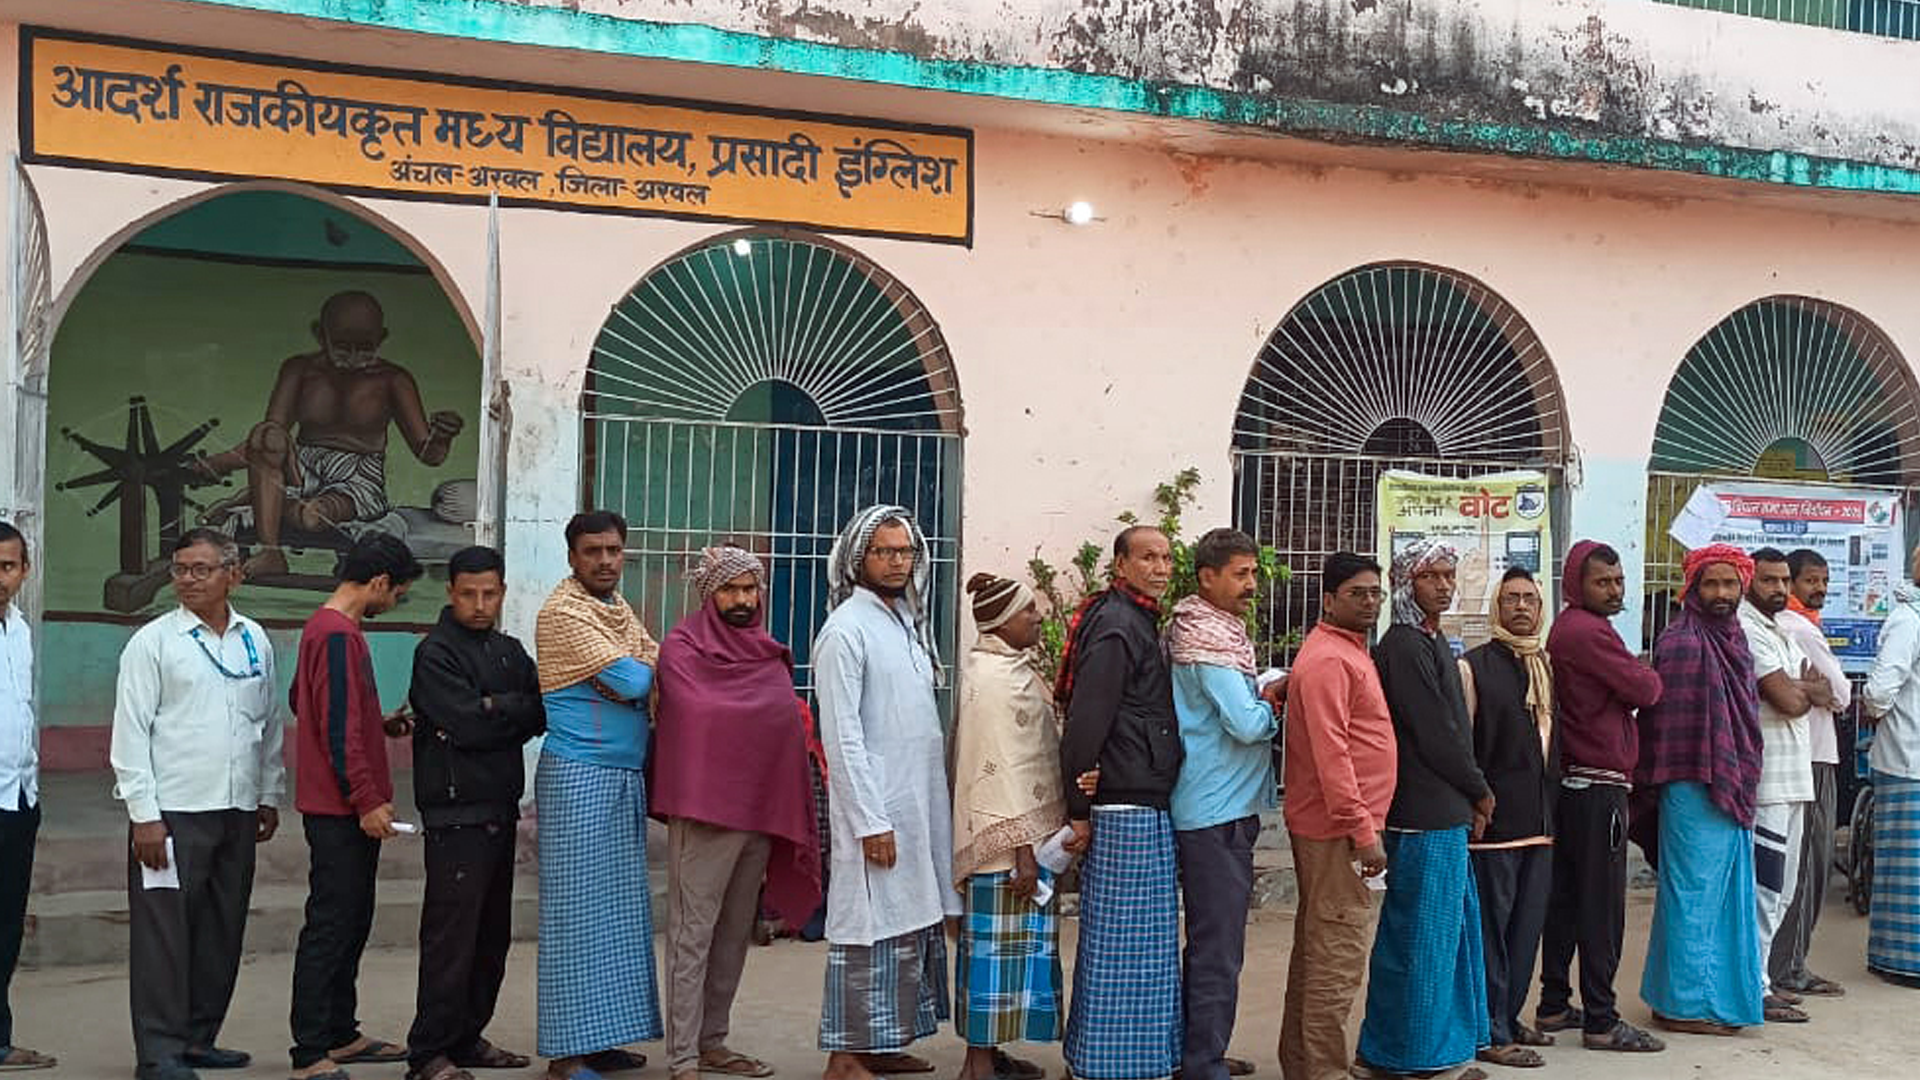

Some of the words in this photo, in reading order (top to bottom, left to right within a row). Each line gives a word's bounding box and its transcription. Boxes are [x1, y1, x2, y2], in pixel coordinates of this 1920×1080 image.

[52, 64, 185, 123] आदर्श
[193, 80, 428, 160] राजकीयकृत
[435, 108, 532, 153] मध्य
[538, 109, 696, 176] विद्यालय,
[707, 132, 822, 184] प्रसादी
[833, 137, 957, 198] इंग्लिश
[1458, 486, 1513, 518] वोट
